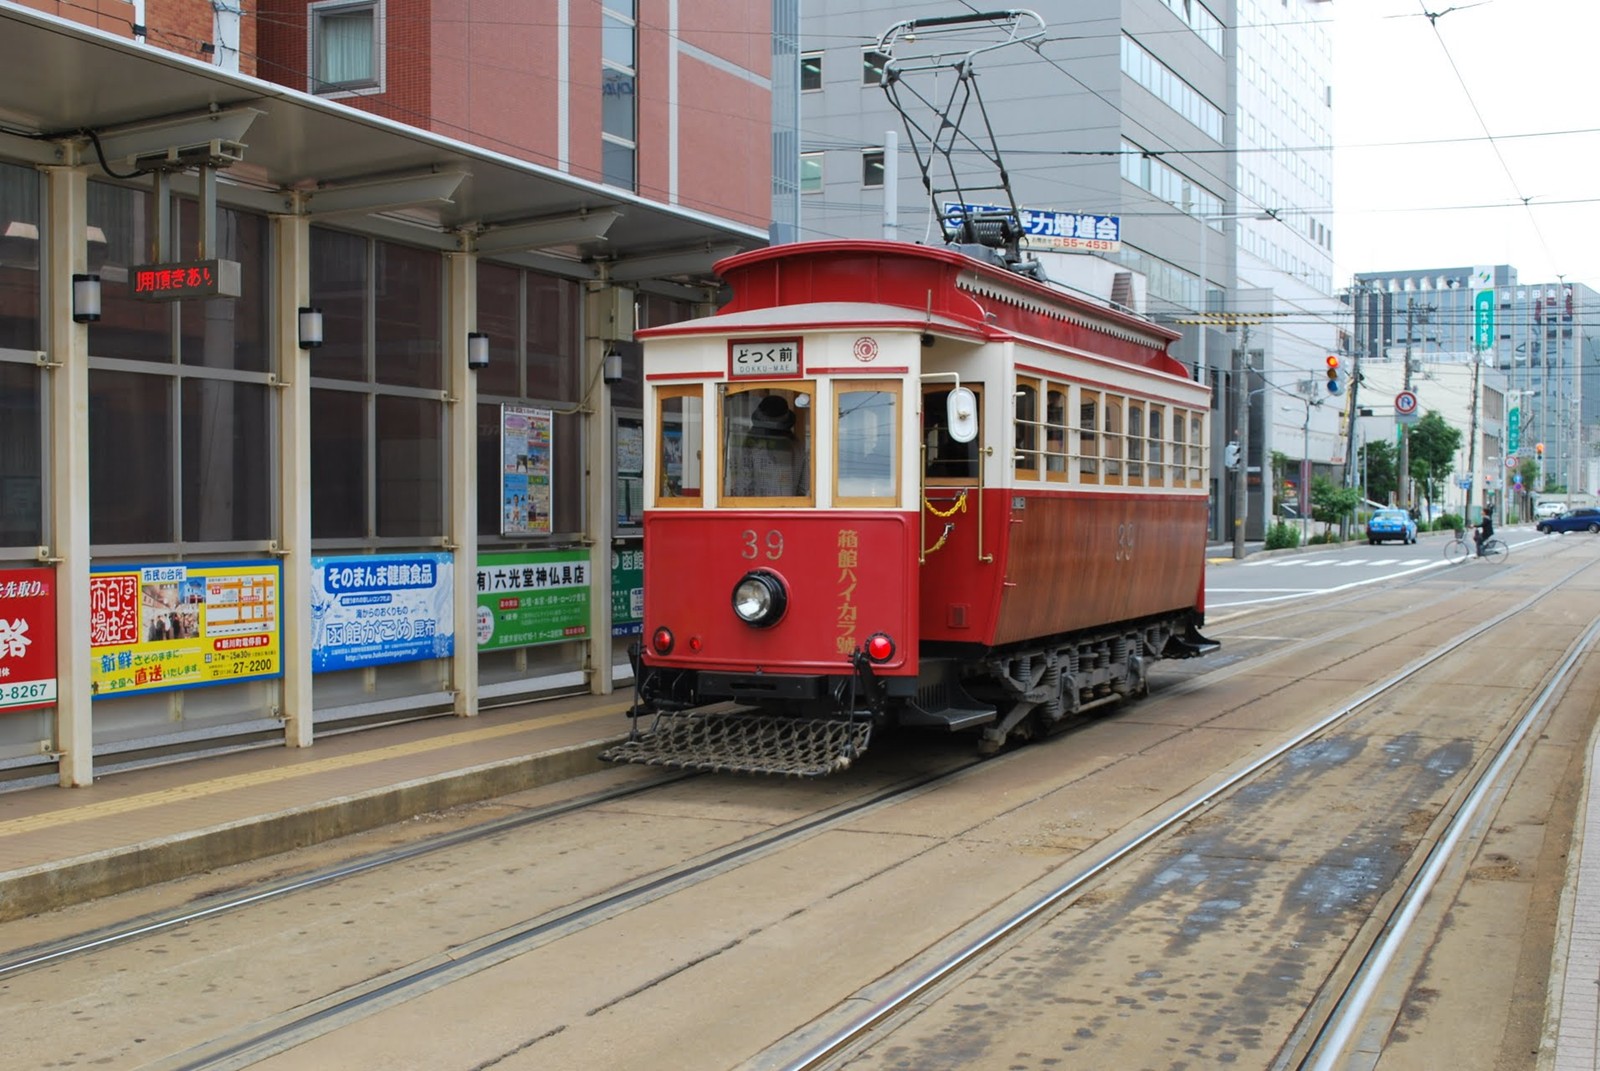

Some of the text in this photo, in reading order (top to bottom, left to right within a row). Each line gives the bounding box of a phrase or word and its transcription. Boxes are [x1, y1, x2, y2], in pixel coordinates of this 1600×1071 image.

[1063, 238, 1113, 250] 55-4531
[136, 267, 213, 292] 用頂きあり
[737, 347, 793, 363] どっく前
[740, 364, 790, 373] DOKKU-MAE
[742, 530, 784, 560] 39
[144, 569, 183, 582] 市民の台所
[328, 564, 432, 588] そのまんま健康食品
[0, 580, 46, 599] 先取り。
[91, 582, 107, 643] 市場
[107, 582, 121, 641] 自由
[121, 580, 135, 639] はこだて
[356, 606, 408, 618] 海からのおくりもの
[326, 617, 436, 646] 函館がごめ昆布
[233, 658, 272, 674] 27-2200
